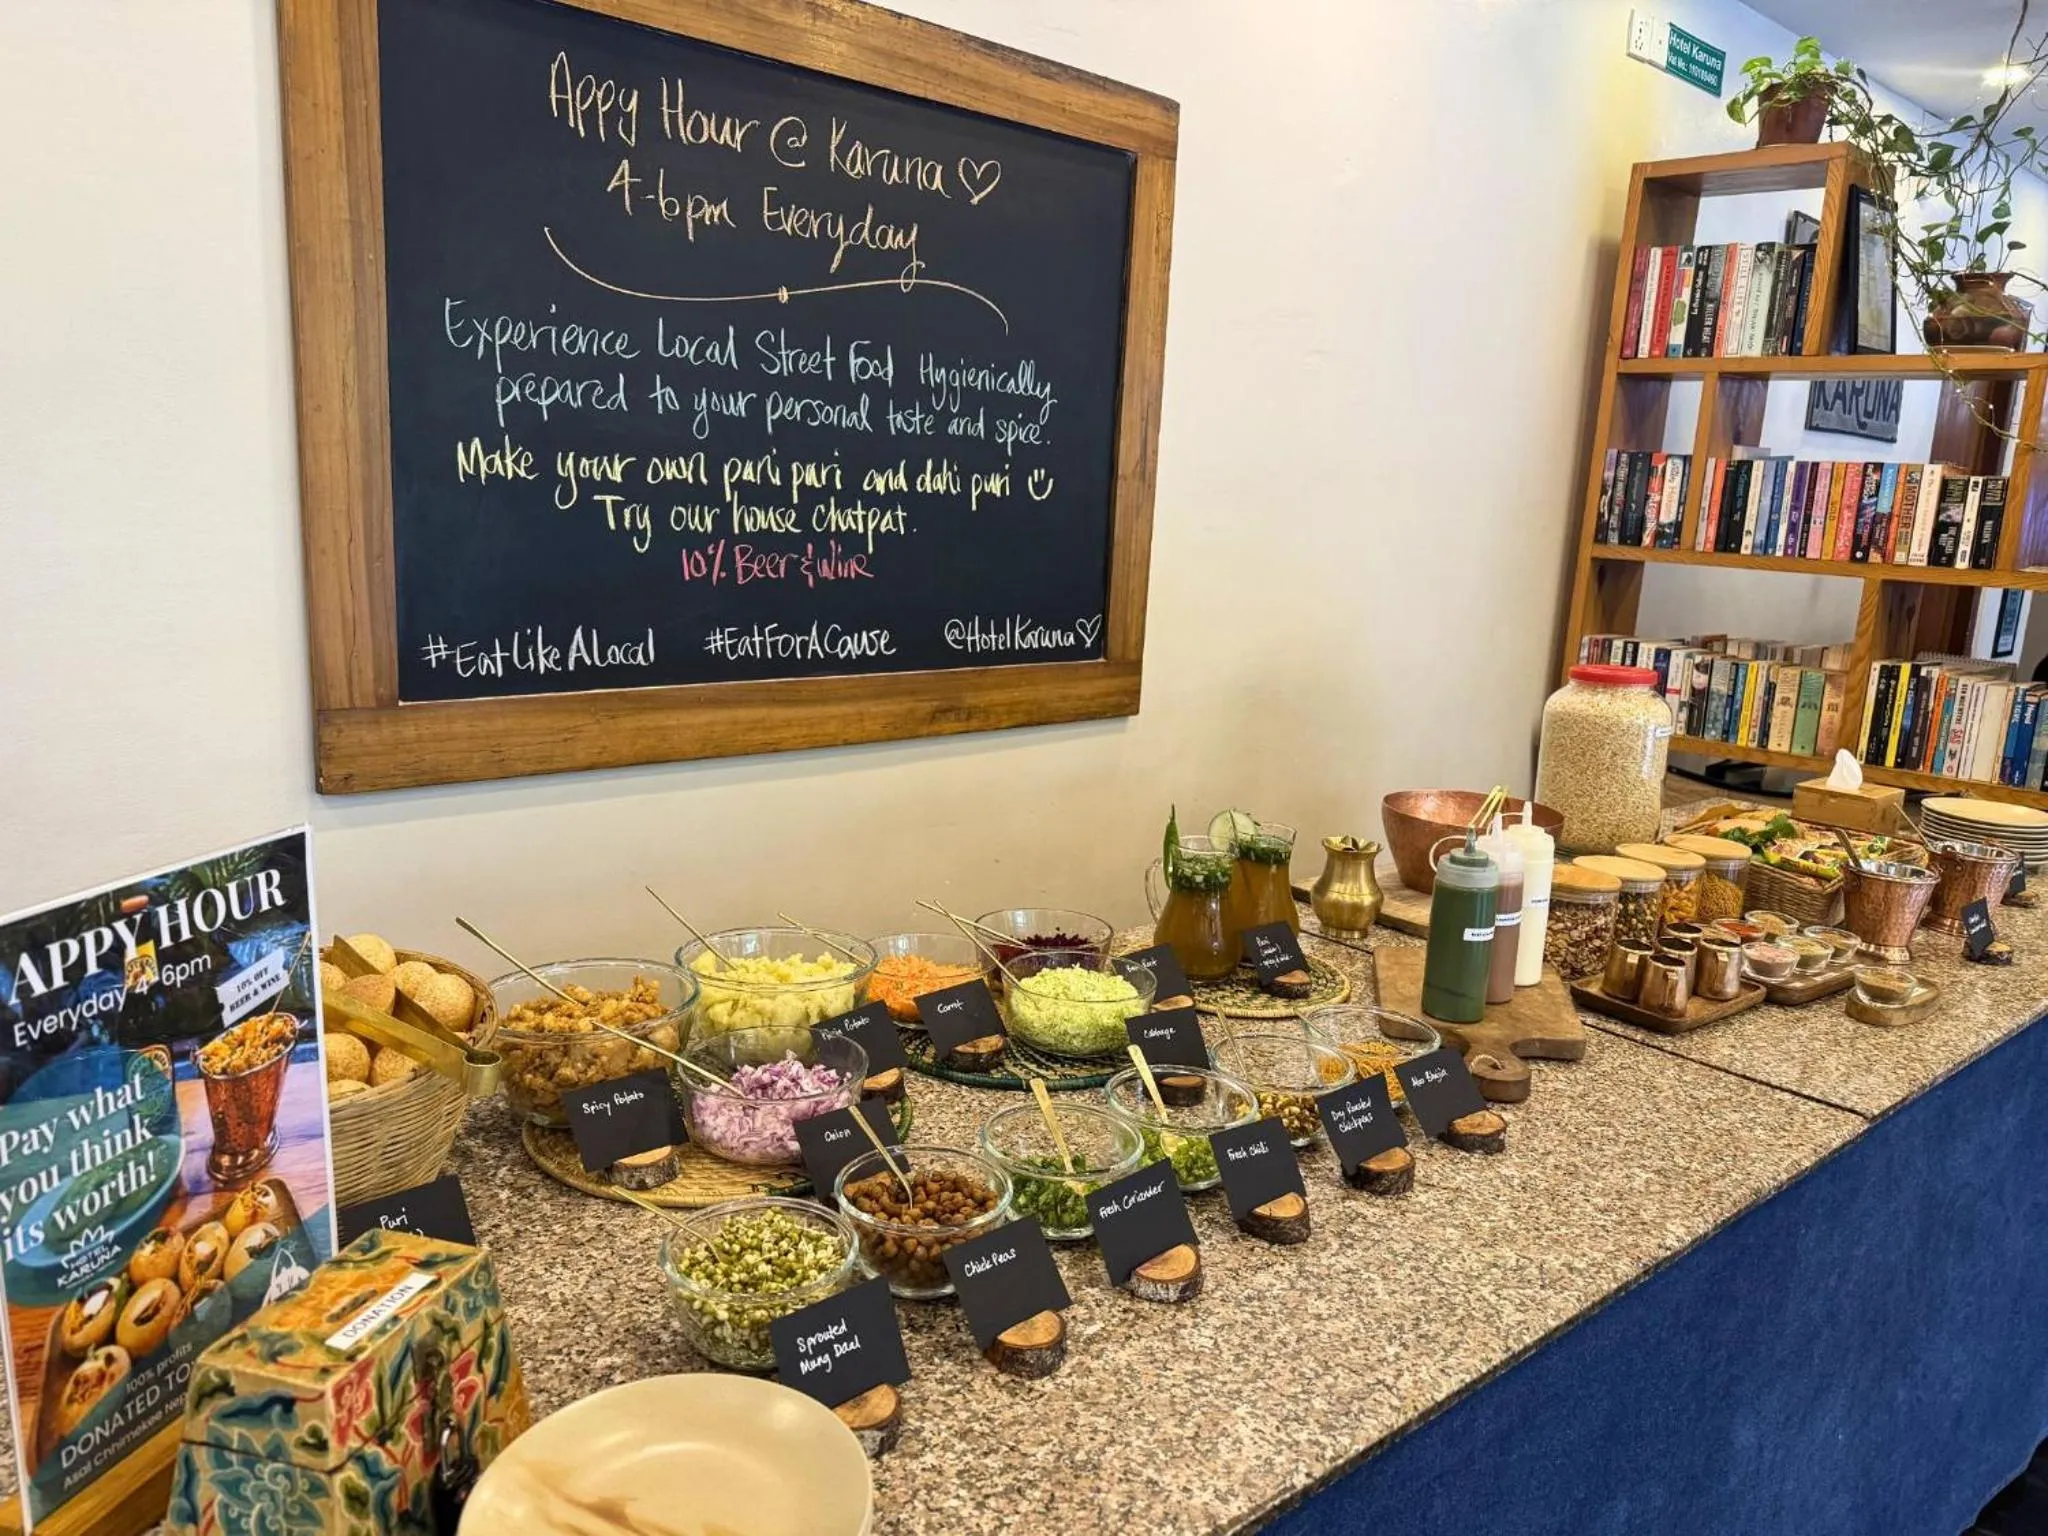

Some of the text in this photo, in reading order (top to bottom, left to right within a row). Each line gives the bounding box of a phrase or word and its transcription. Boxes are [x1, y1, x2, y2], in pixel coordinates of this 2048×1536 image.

[1669, 30, 1691, 55] Hotel
[1692, 43, 1722, 70] Karuna
[549, 51, 952, 200] Appy Hour @ Karuna
[606, 158, 926, 293] 4-6pm Everyday
[445, 297, 641, 374] Experience
[755, 327, 837, 381] Street
[849, 340, 894, 388] Food
[919, 351, 1058, 426] Hygienically
[496, 372, 629, 428] prepared
[649, 374, 680, 415] to
[692, 386, 757, 440] your
[765, 390, 874, 435] personal
[885, 398, 936, 436] taste
[947, 405, 985, 440] and
[1814, 380, 1903, 430] KARUNA
[457, 434, 540, 485] Make
[555, 450, 637, 510] your
[646, 451, 708, 486] own
[862, 458, 908, 496] and
[916, 457, 962, 495] dahi
[971, 463, 1011, 511] puri
[593, 494, 652, 553] Try
[670, 503, 721, 534] our
[733, 491, 802, 534] house
[1901, 486, 1918, 530] MOTHER
[682, 540, 727, 587] 10%
[734, 543, 799, 585] Beer
[704, 619, 897, 660] #EatForACause
[944, 613, 1076, 651] @HotelKaruna
[1951, 728, 1964, 745] SAS
[8, 868, 287, 1006] APPY HOUR
[229, 992, 252, 1013] BEER
[260, 972, 282, 991] WINE
[236, 978, 253, 993] 10%
[13, 986, 127, 1048] Everyday
[0, 1072, 145, 1168] Pay what
[582, 1098, 613, 1117] Spicy
[0, 1112, 154, 1224] you think
[1, 1149, 157, 1264] its worth!
[379, 1206, 409, 1231] Puri
[1099, 1180, 1166, 1220] Fresh Coriander
[56, 1245, 123, 1289] KARUNA
[70, 1245, 109, 1270] HOTEL
[964, 1255, 993, 1278] Chick
[342, 1283, 415, 1339] DONATION
[796, 1318, 849, 1355] Sprouted
[126, 1341, 194, 1394] 100% profits
[800, 1350, 834, 1377] Mung
[60, 1384, 161, 1470] DONATED
